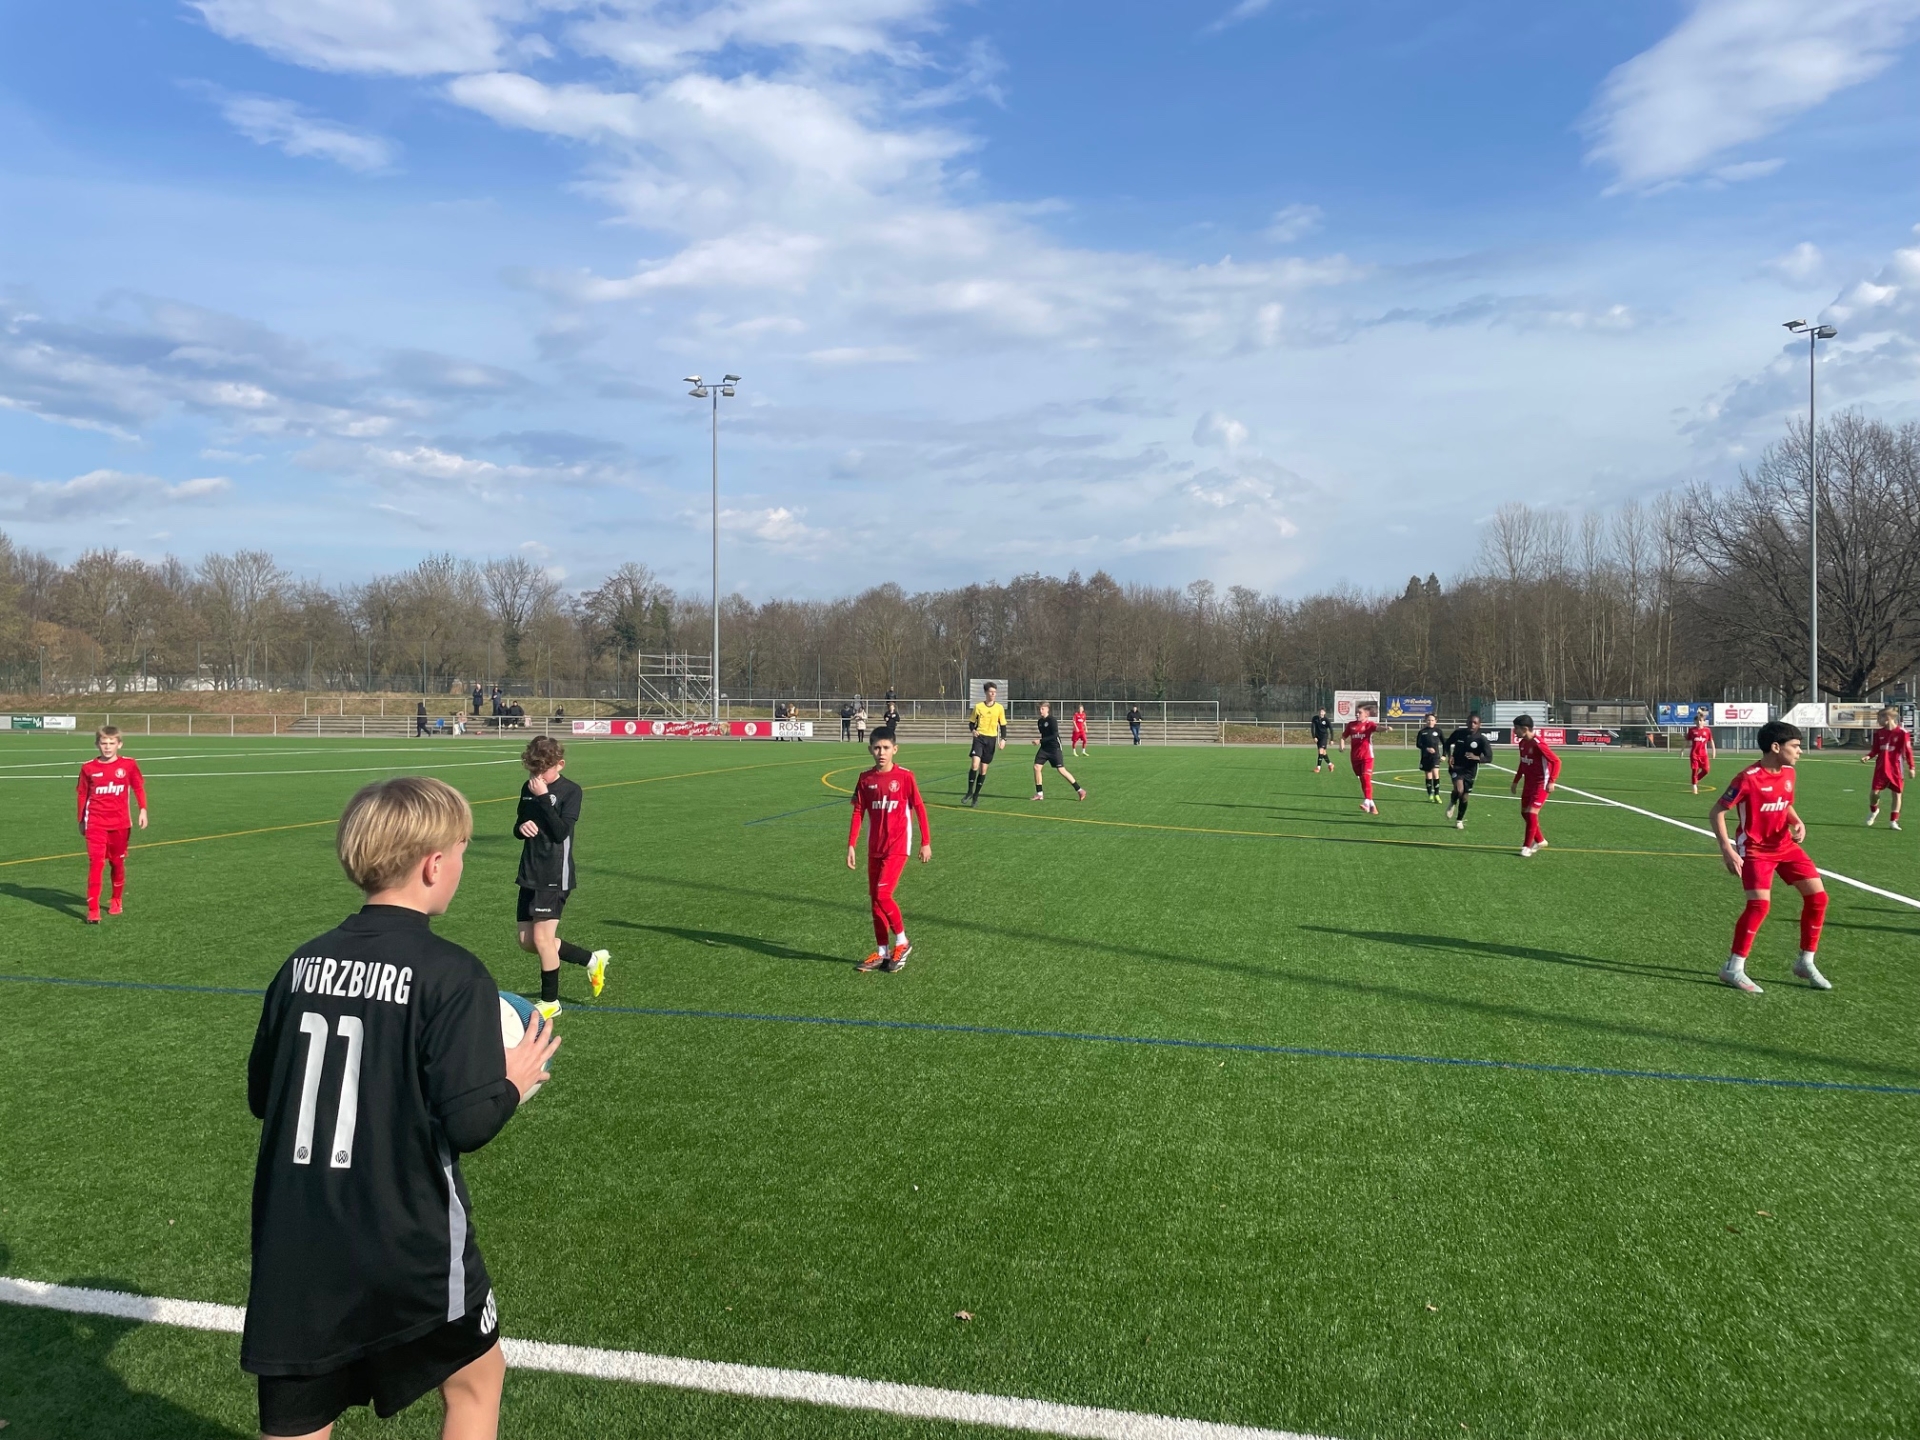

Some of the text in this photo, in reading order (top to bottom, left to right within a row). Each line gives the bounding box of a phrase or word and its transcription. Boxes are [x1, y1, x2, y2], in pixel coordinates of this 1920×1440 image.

[779, 723, 805, 731] ROSE
[95, 782, 125, 796] mhp
[872, 795, 899, 813] mhp
[291, 957, 412, 1005] WÜRZBURG
[293, 1011, 364, 1168] 11
